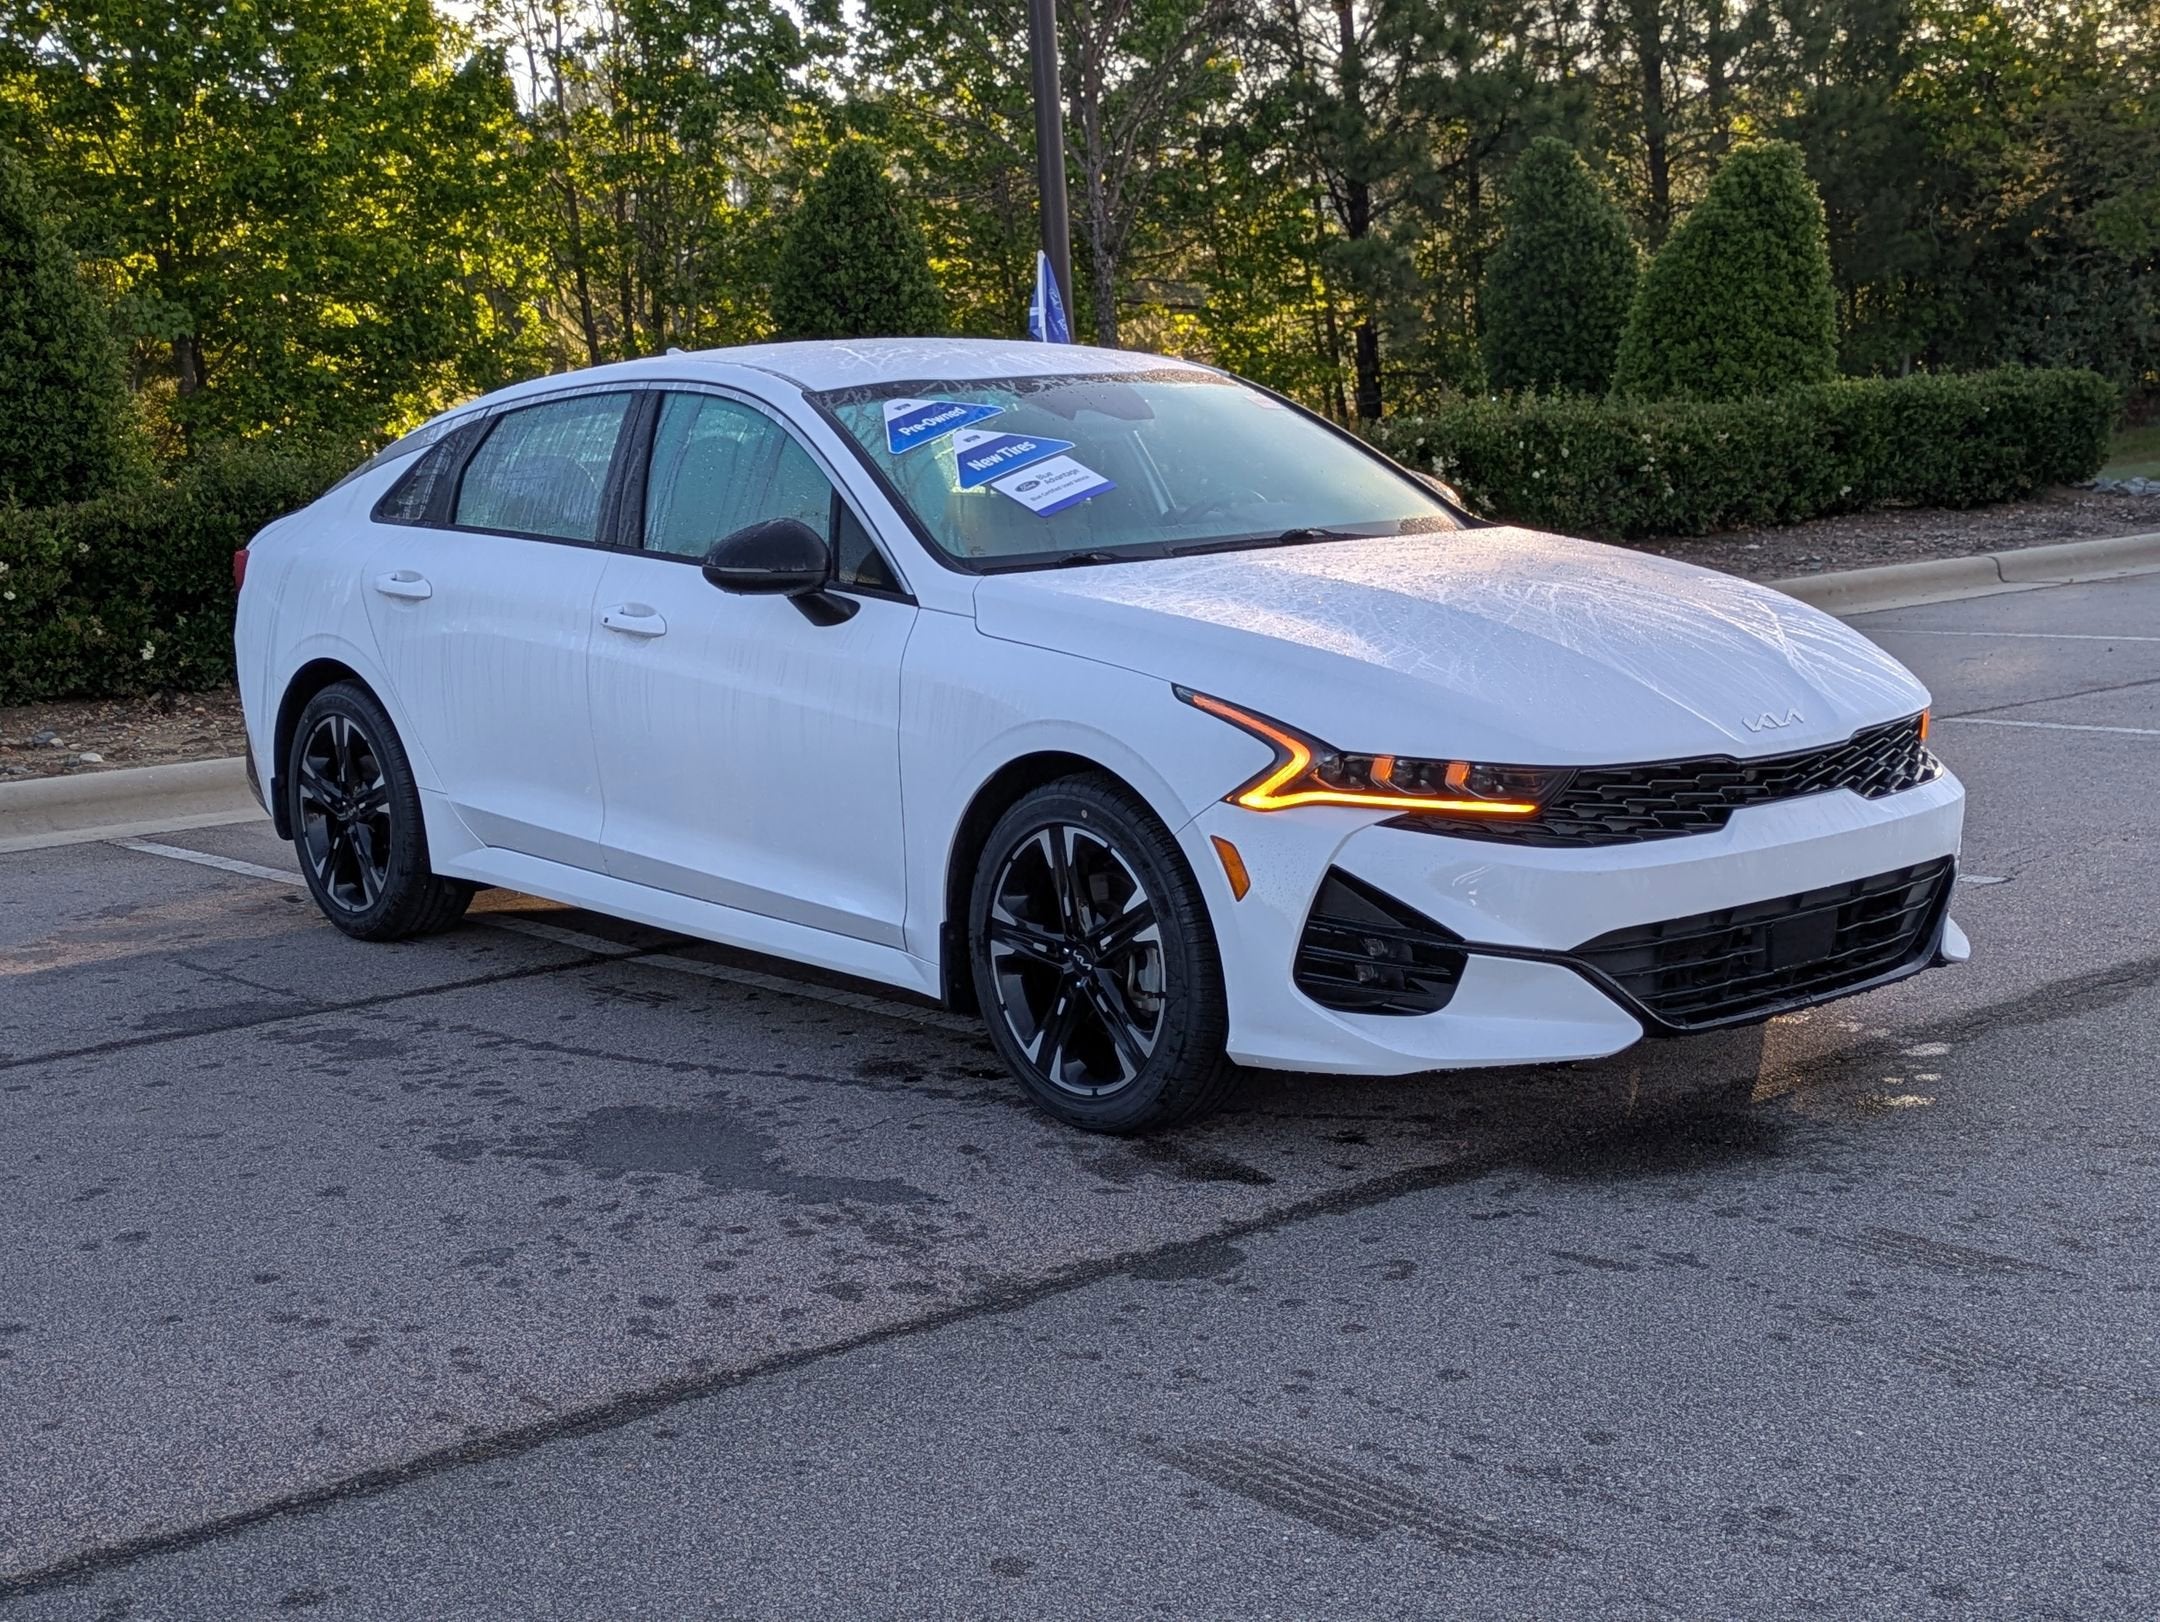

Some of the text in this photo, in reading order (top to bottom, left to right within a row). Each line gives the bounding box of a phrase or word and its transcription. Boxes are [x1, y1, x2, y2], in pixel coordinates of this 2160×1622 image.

[898, 407, 967, 436] Pre-Owned
[966, 441, 1037, 471] New Tires
